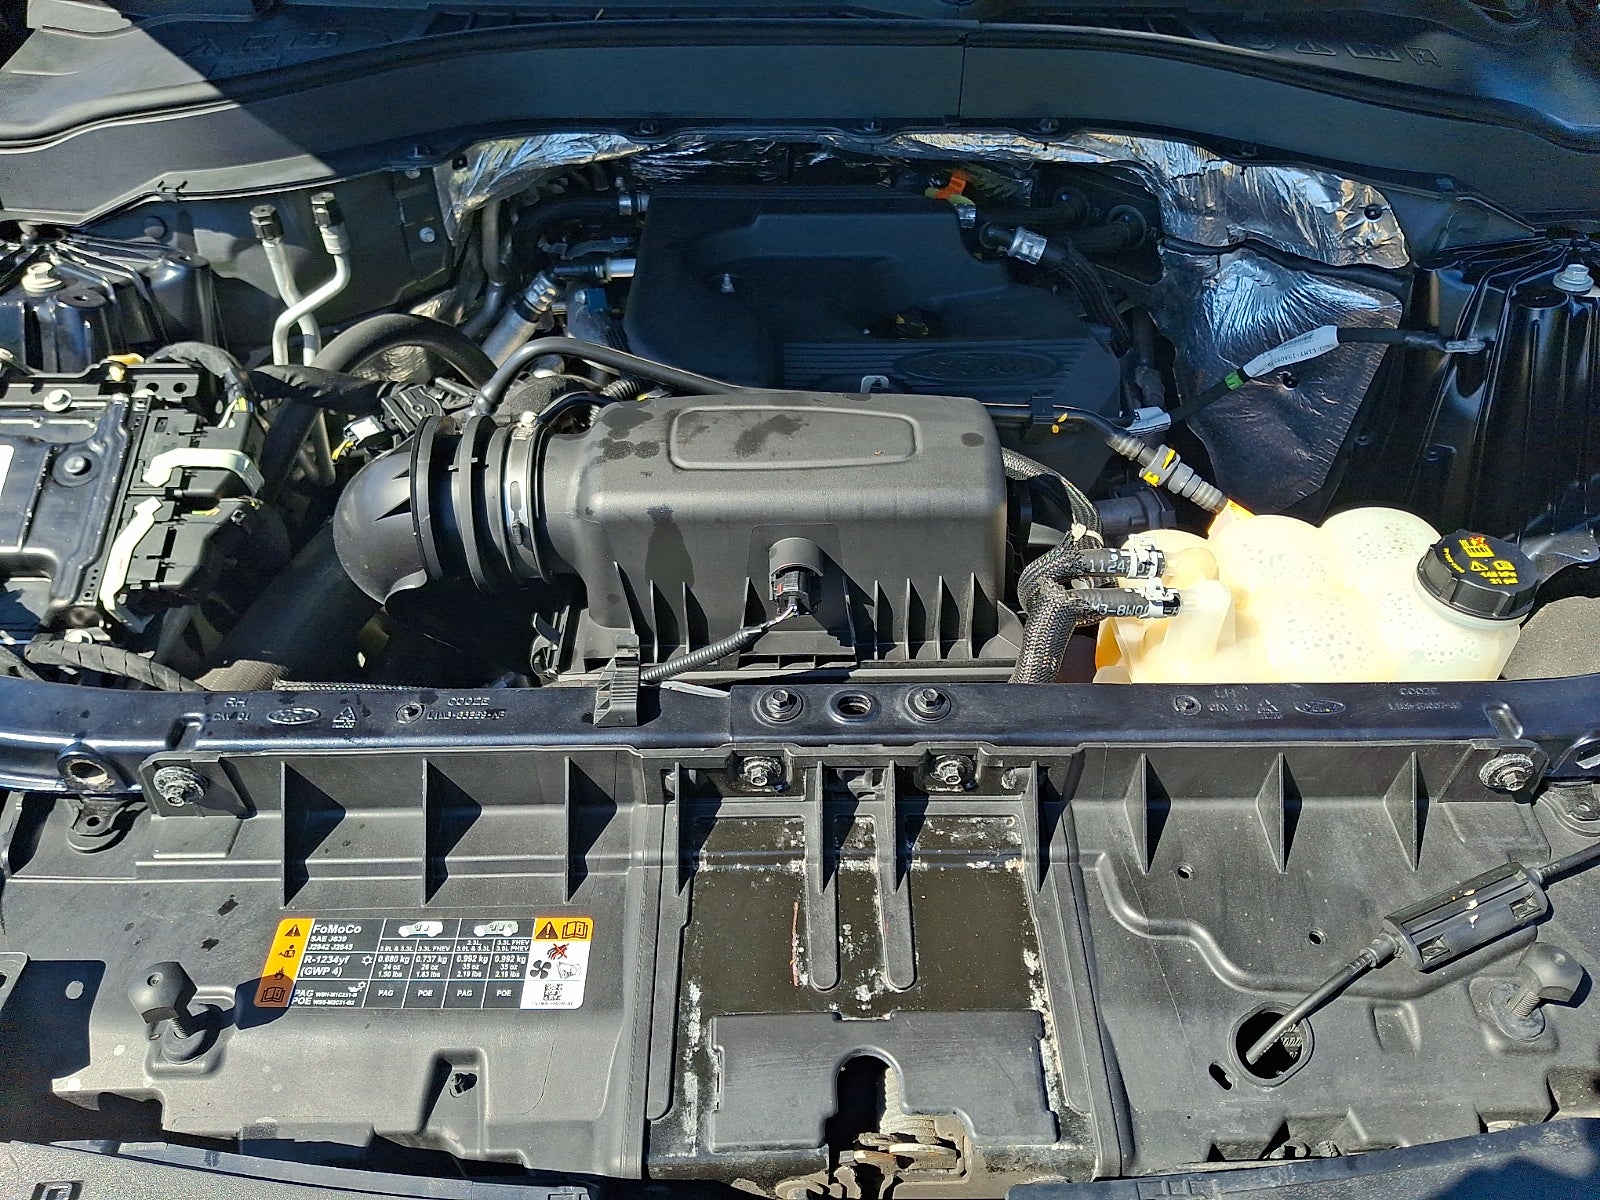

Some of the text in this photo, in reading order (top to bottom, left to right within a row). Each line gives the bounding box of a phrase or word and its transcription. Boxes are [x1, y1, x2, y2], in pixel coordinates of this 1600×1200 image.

[225, 696, 249, 707] RH
[312, 924, 362, 934] FoMoCo
[304, 955, 350, 966] R-1234yf
[378, 955, 411, 964] 0.680 kg
[415, 955, 448, 964] 0.737 kg
[456, 955, 489, 964] 0.992 kg
[494, 955, 527, 964] 0.992 kg
[300, 967, 342, 977] (GWP 4)
[294, 989, 314, 997] PAG
[291, 997, 312, 1005] POE
